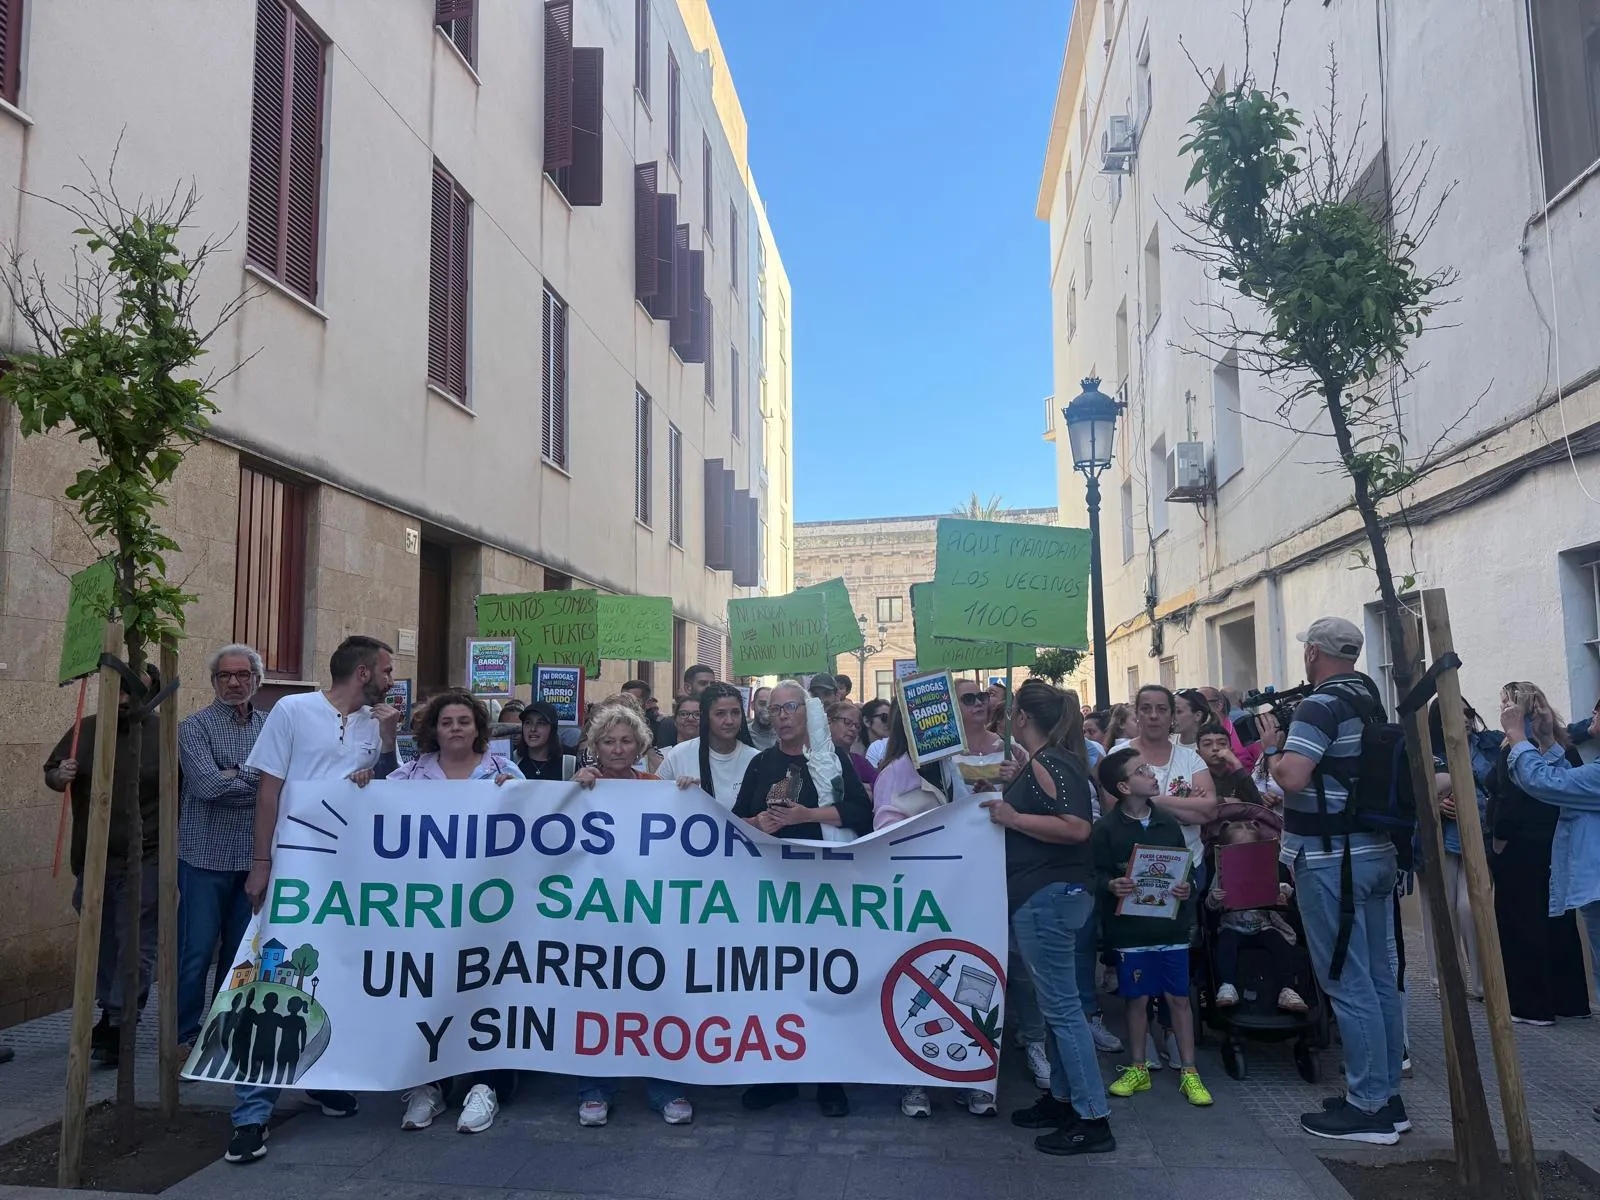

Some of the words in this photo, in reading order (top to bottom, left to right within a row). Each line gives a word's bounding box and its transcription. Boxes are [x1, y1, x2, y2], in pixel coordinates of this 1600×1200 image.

[406, 533, 417, 551] 5-7
[1009, 536, 1087, 562] MANDAN
[952, 570, 990, 590] LOS
[1005, 572, 1083, 599] VECINOS
[484, 597, 545, 623] JUNTOS
[549, 596, 594, 617] SOMOS
[964, 600, 1038, 628] 11006
[542, 623, 596, 646] FUERTES
[604, 632, 626, 645] QUE
[771, 621, 785, 639] NI
[739, 644, 777, 662] BARRIO
[783, 641, 818, 660] UNIDO
[478, 658, 504, 666] BARRIO
[543, 672, 550, 680] NI
[551, 672, 575, 681] DROGAS
[543, 687, 574, 697] BARRIO
[545, 695, 571, 704] UNIDO
[907, 688, 916, 699] NI
[916, 681, 944, 696] DROGAS
[912, 702, 949, 722] BARRIO
[918, 713, 948, 731] UNIDO
[373, 811, 616, 860] UNIDOS
[639, 812, 762, 858] POR
[269, 877, 515, 929] BARRIO
[536, 874, 740, 925] SANTA
[757, 873, 953, 933] MARÍA
[362, 950, 434, 998] UN
[457, 940, 666, 993] BARRIO
[685, 945, 859, 995] LIMPIO
[416, 1016, 455, 1064] Y
[468, 1005, 556, 1052] SIN
[574, 1011, 807, 1064] DROGAS
